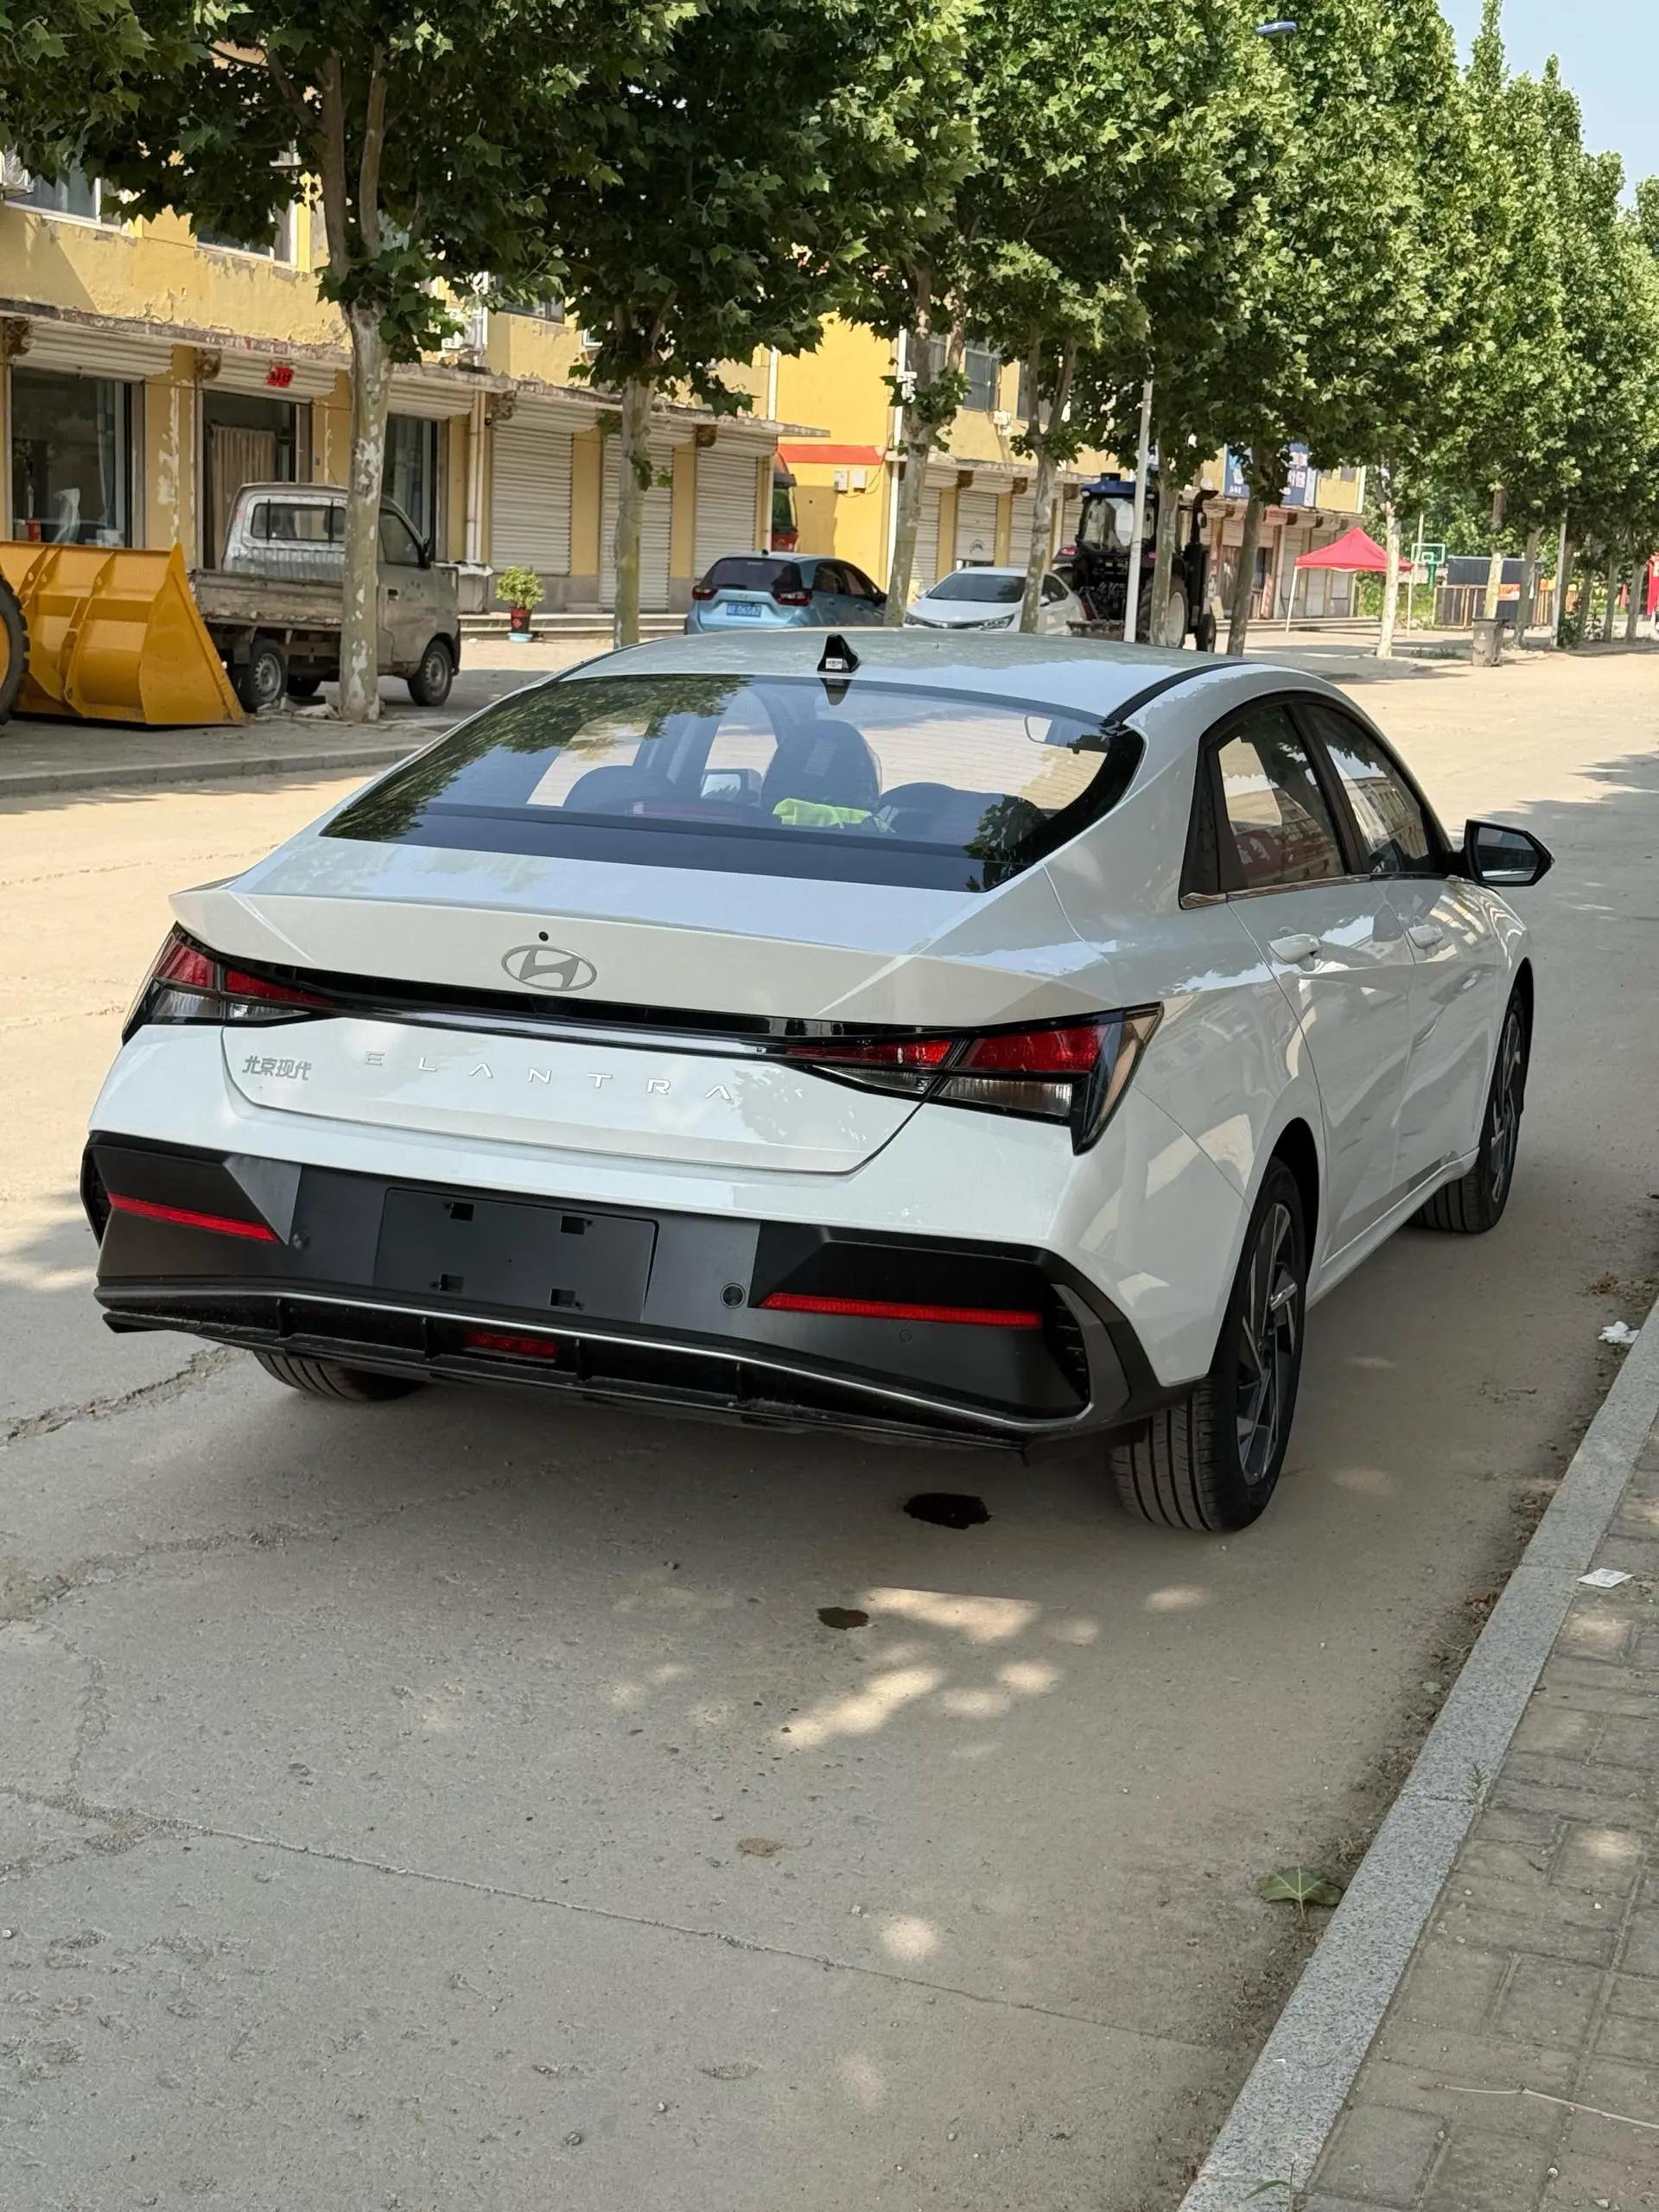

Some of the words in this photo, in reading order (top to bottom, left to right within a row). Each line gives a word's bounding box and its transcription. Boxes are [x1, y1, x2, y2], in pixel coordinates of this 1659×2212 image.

[241, 1055, 312, 1081] 北京现代
[364, 1050, 732, 1101] ELANTRA
